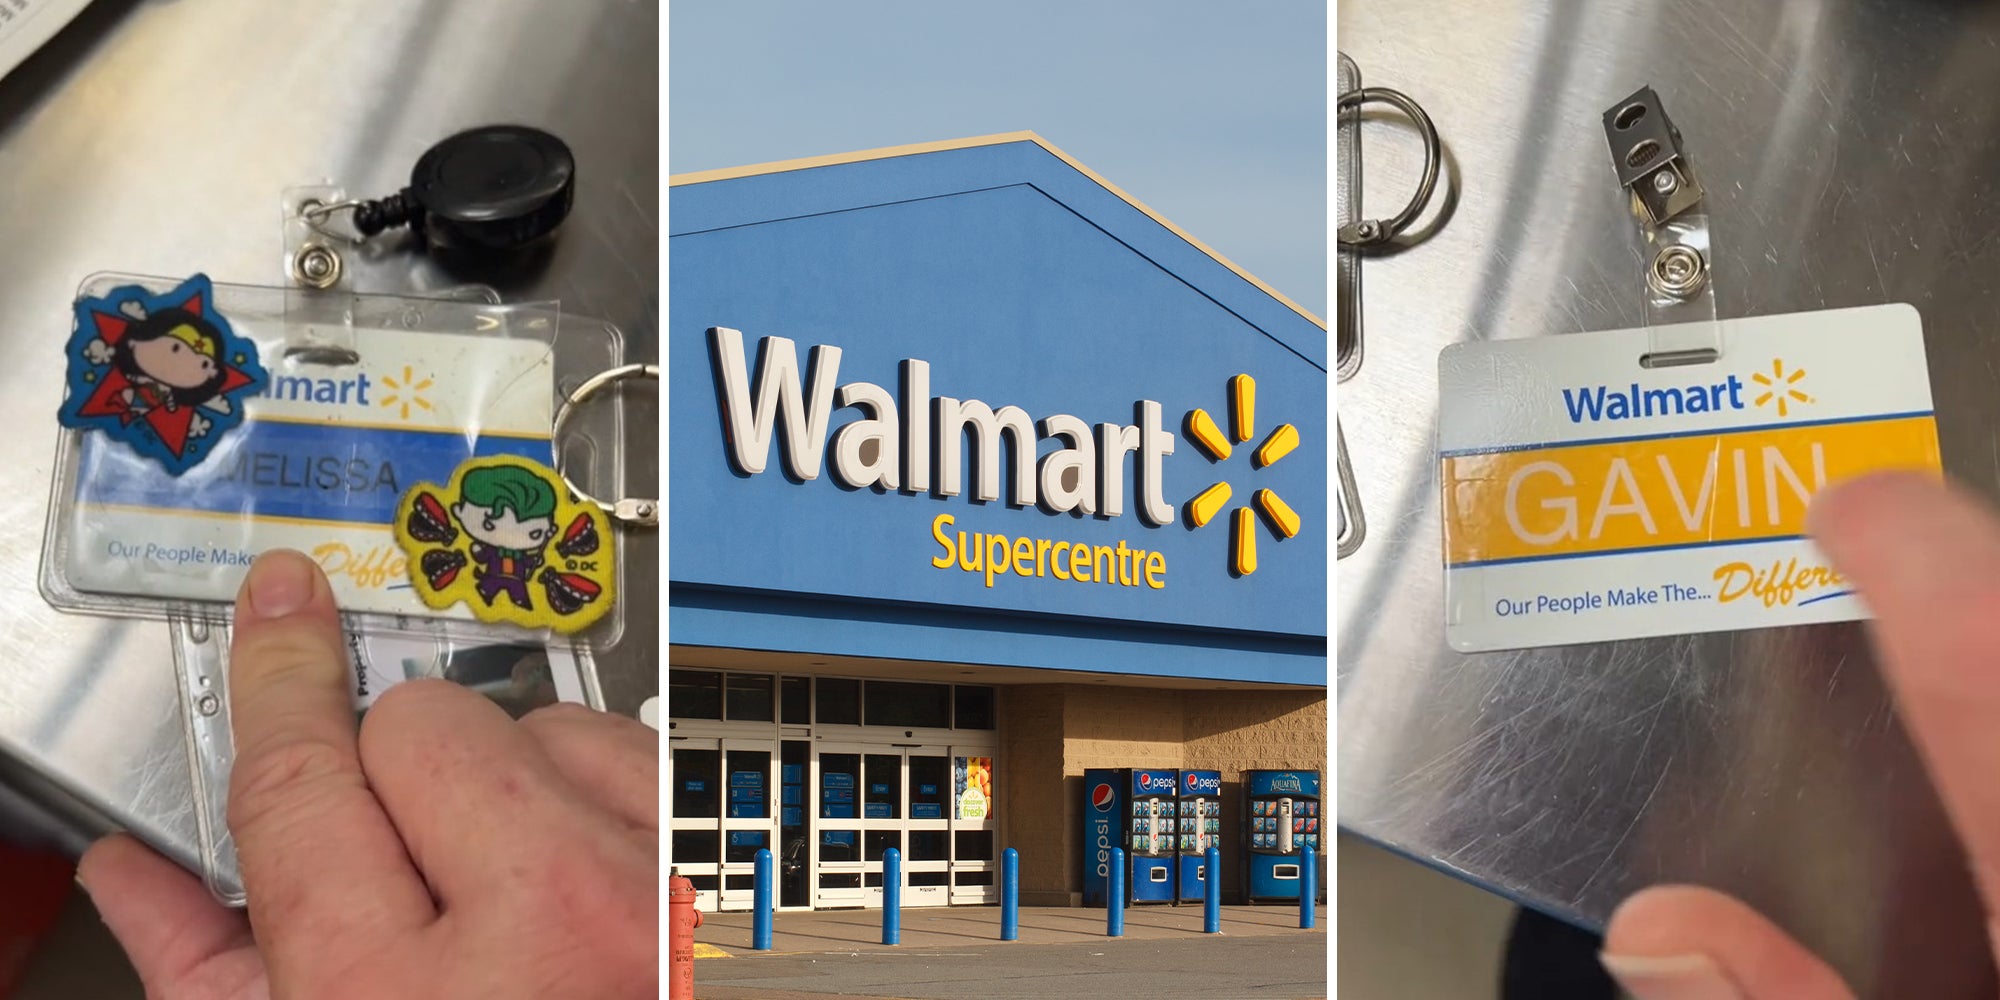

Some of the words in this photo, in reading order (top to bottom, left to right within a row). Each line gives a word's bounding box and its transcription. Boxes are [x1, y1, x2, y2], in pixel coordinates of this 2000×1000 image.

[262, 368, 371, 406] lmart
[1562, 374, 1745, 424] Walmart
[706, 327, 1174, 527] Walmart
[220, 453, 399, 494] MELISSA
[1503, 442, 1826, 546] GAVIN
[107, 540, 140, 558] Our
[144, 543, 206, 564] People
[312, 542, 407, 589] Diffe
[580, 561, 599, 572] DC
[931, 513, 1167, 590] Supercentre
[1495, 599, 1532, 617] Our
[1537, 590, 1602, 614] People
[1607, 588, 1659, 607] Make
[1661, 583, 1711, 602] The...
[1152, 776, 1176, 790] pepsi
[963, 806, 984, 817] fresh
[1095, 819, 1111, 877] pepsi
